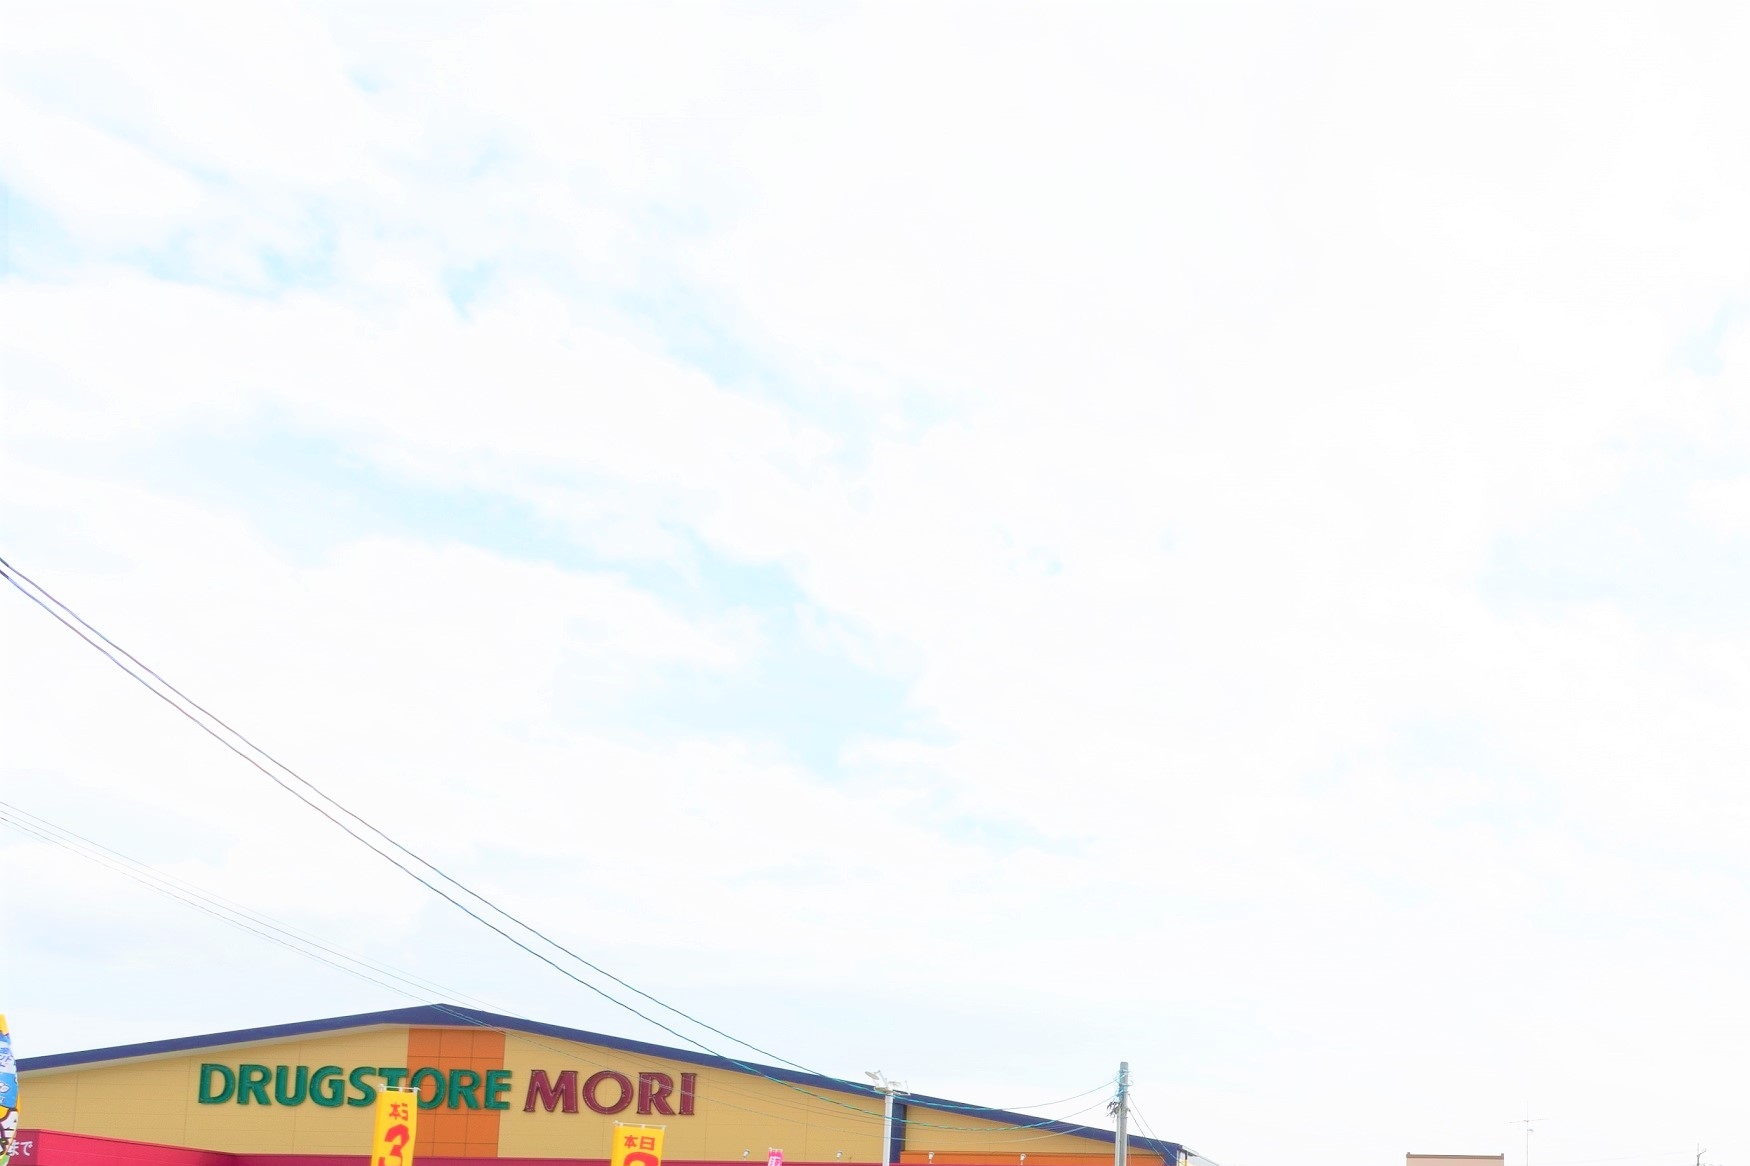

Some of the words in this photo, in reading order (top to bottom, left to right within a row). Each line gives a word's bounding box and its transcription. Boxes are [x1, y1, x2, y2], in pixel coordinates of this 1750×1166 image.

[198, 1063, 512, 1110] DRUGSTORE
[523, 1069, 697, 1116] MORI
[624, 1135, 656, 1151] 本日
